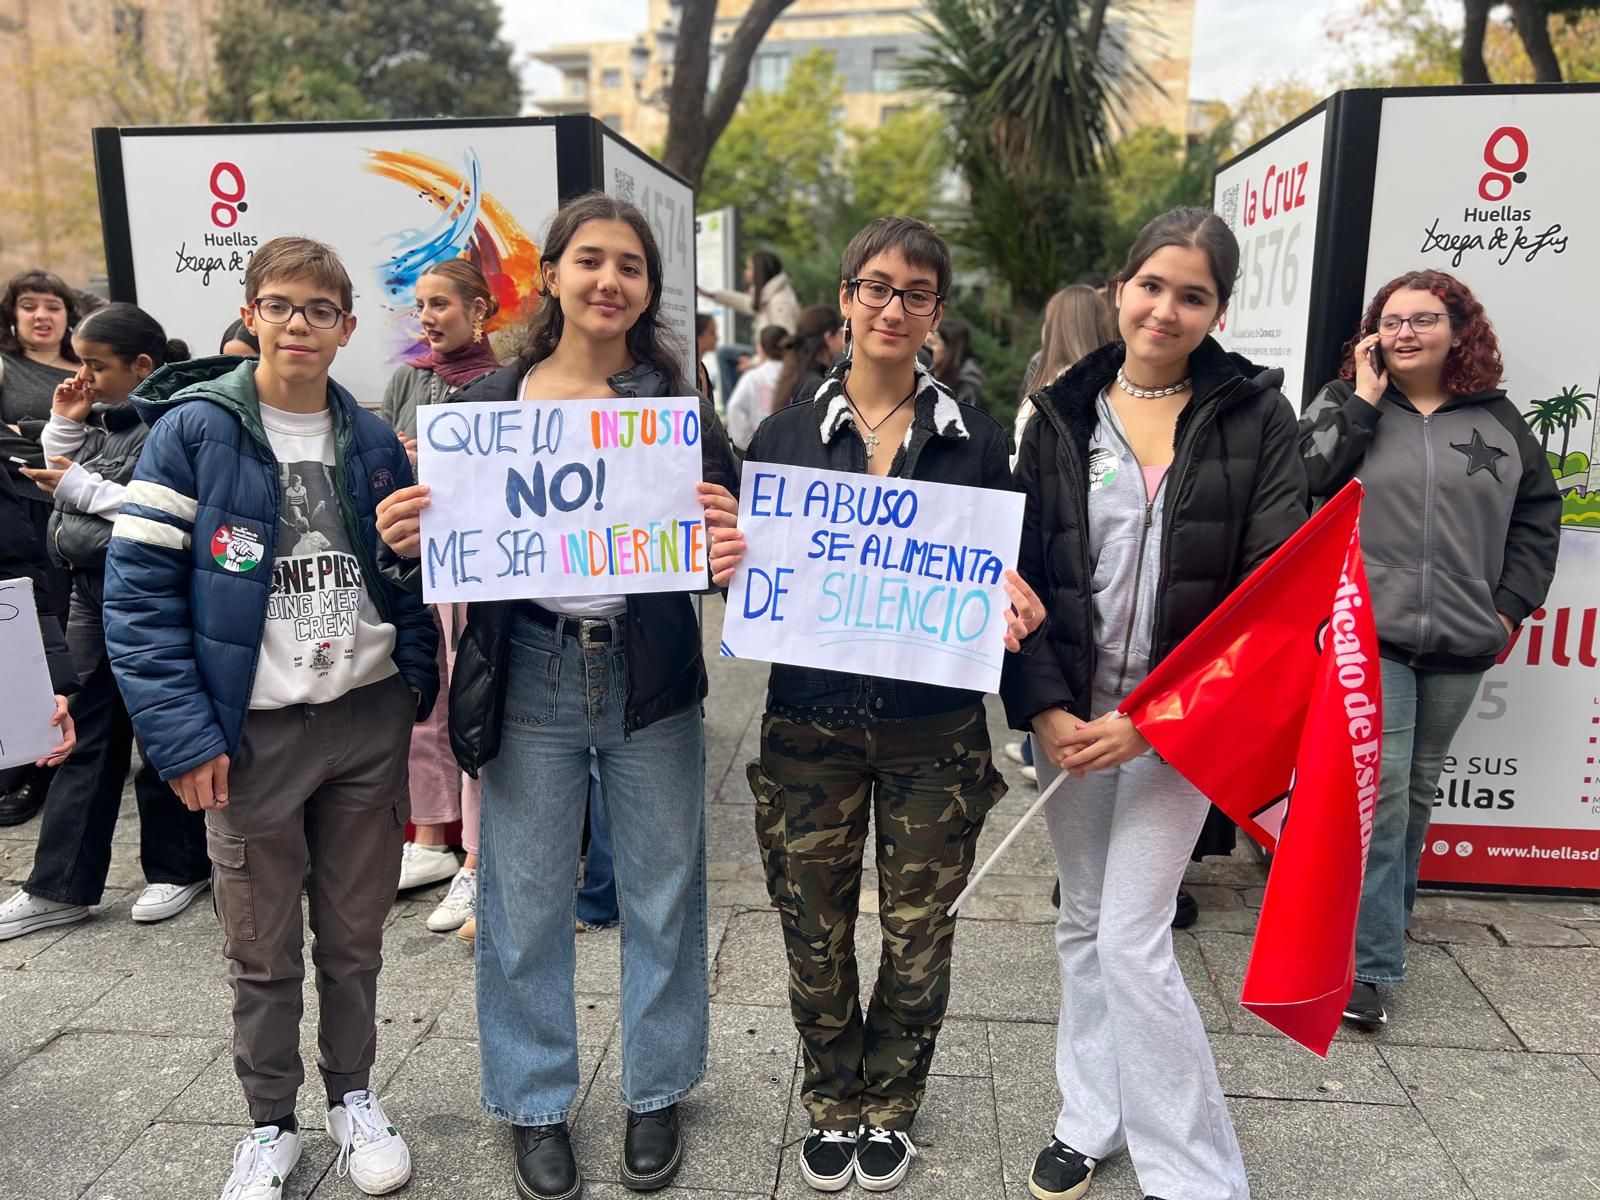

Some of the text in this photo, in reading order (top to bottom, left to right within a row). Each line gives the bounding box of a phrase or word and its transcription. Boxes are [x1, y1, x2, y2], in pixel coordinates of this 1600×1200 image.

[1243, 161, 1308, 227] la Cruz
[1464, 205, 1531, 222] Huellas
[204, 231, 258, 246] Huellas
[1240, 222, 1301, 312] 1576
[427, 408, 699, 456] QUE LO INJUSTO
[505, 457, 606, 518] NO!
[750, 473, 918, 528] EL ABUSO
[317, 554, 362, 591] PIEC
[427, 519, 704, 588] ME SEA INDIFERENTE
[808, 530, 1003, 585] SE ALIMENTA
[319, 588, 362, 615] MER
[743, 567, 991, 643] DE SILENCIO
[294, 612, 355, 642] CREW
[1343, 692, 1377, 740] de
[1442, 755, 1518, 776] e sus
[1431, 779, 1516, 810] ellas
[1487, 845, 1600, 861] www.huellasd
